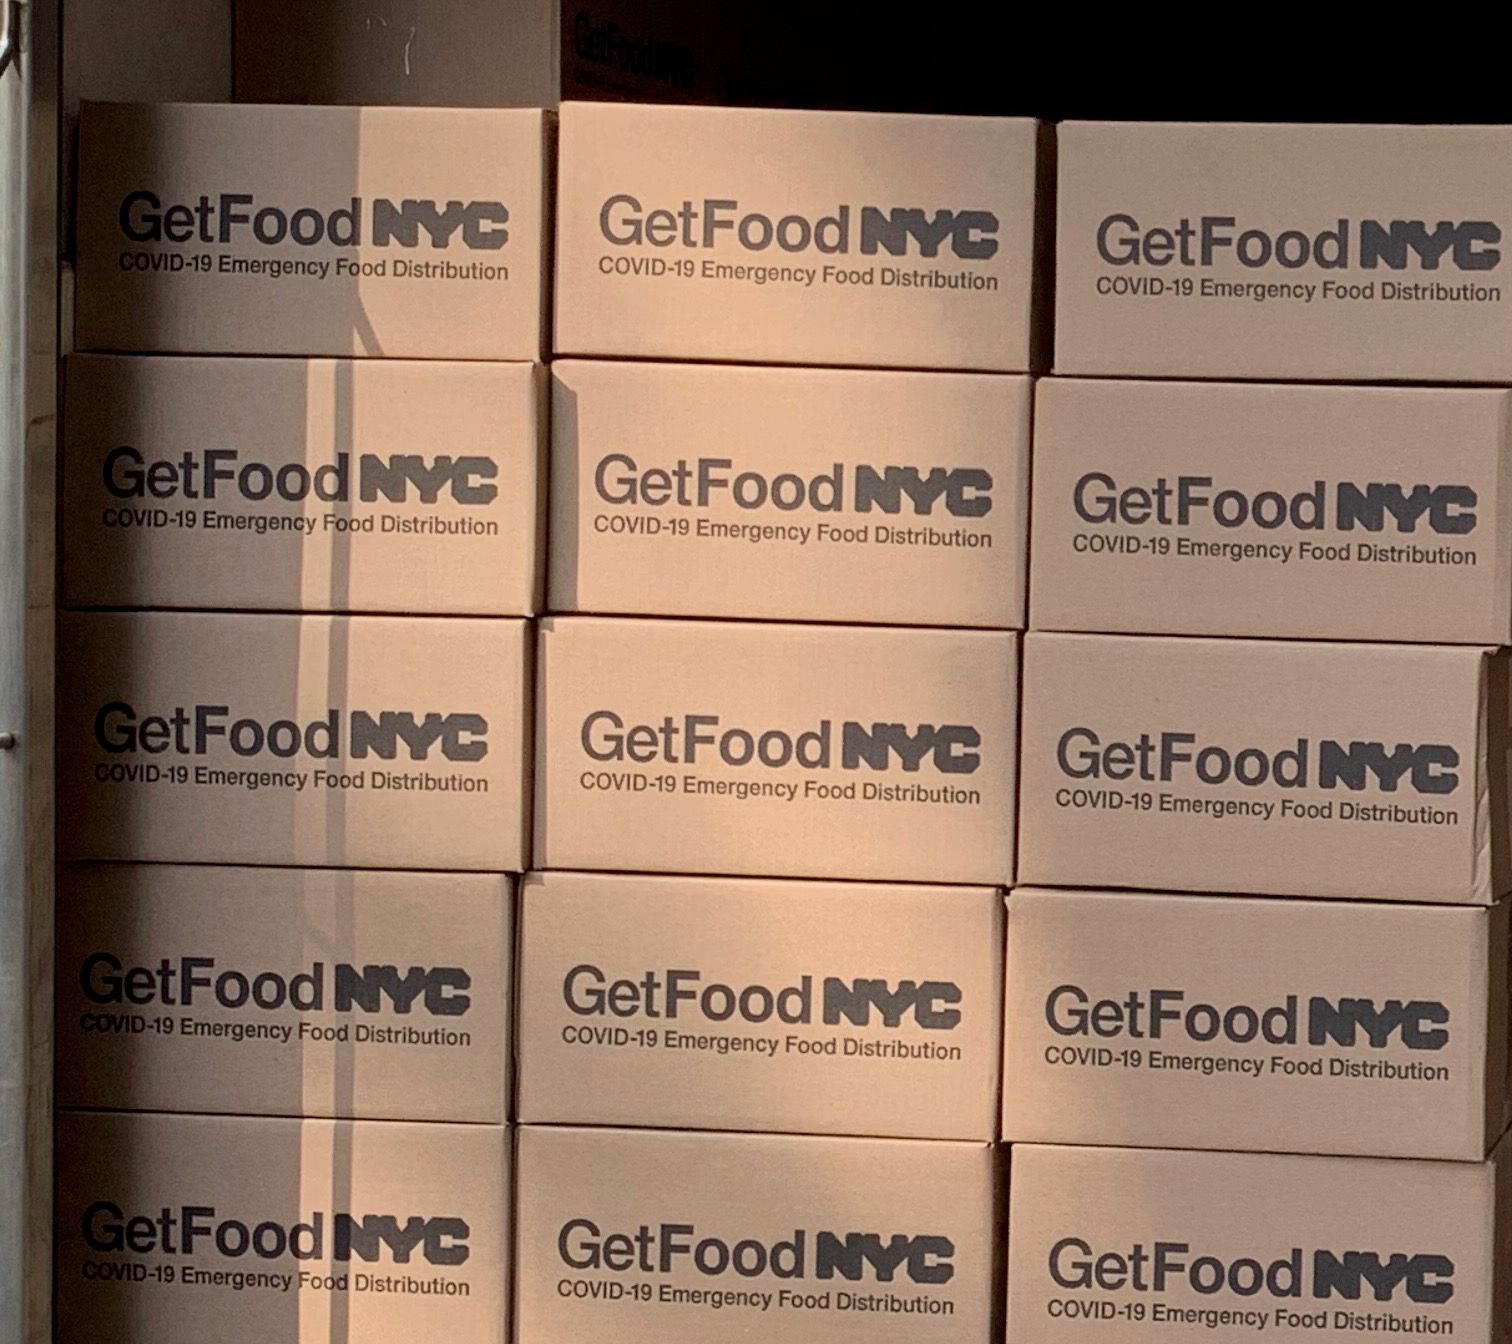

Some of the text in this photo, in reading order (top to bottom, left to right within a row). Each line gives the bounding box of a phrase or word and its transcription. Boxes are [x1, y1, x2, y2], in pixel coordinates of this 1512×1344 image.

[119, 251, 509, 280] COVID-19 Emergency Food Distribution
[1097, 275, 1500, 302] COVID-19 Emergency Food Distribution
[594, 514, 992, 548] COVID-19 Emergency Food Distribution
[95, 762, 488, 792] COVID-19 Emergency Food Distribution
[562, 1025, 961, 1060] COVID-19 Emergency Food Distribution
[1048, 1298, 1453, 1334] COVID-19 Emergency Food Distribution
